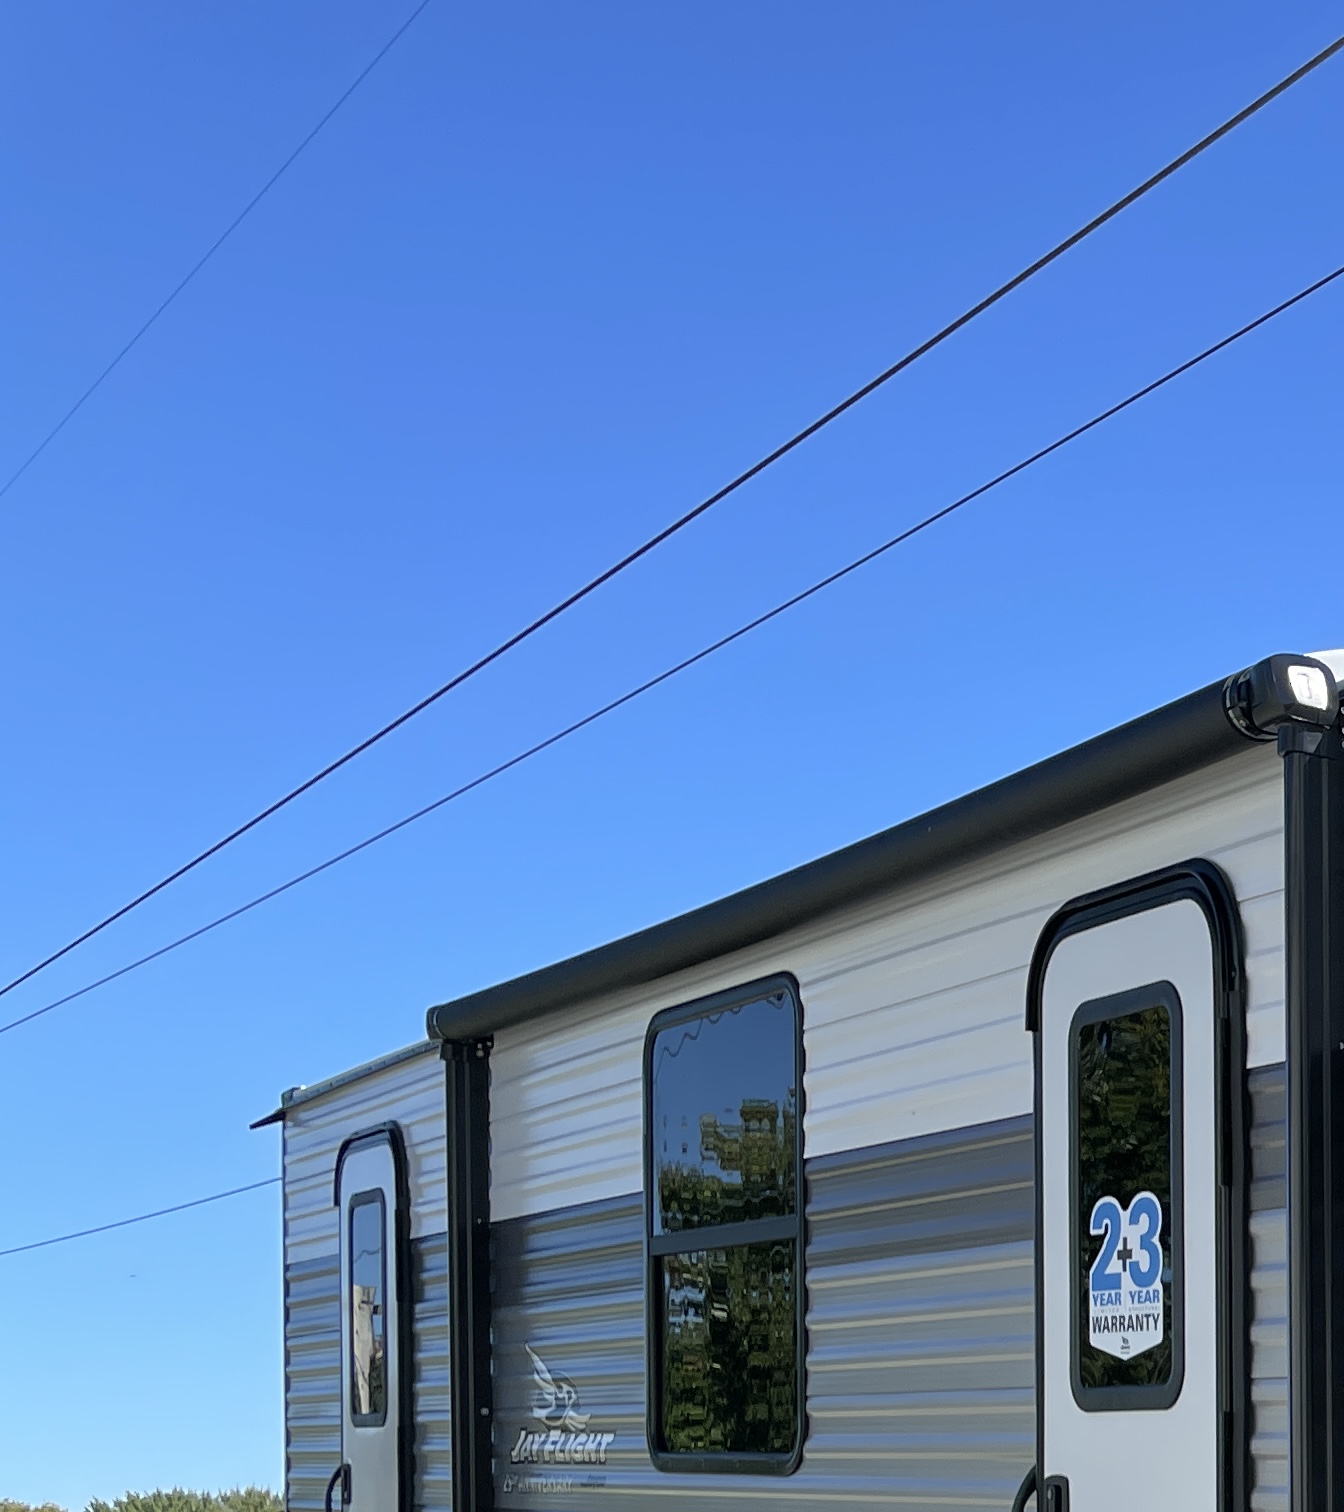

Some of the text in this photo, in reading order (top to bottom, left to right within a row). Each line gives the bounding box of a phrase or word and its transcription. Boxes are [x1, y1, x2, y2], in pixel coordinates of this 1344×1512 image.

[1093, 1290, 1160, 1308] YEAR YEAR
[1092, 1313, 1160, 1334] WARRANTY
